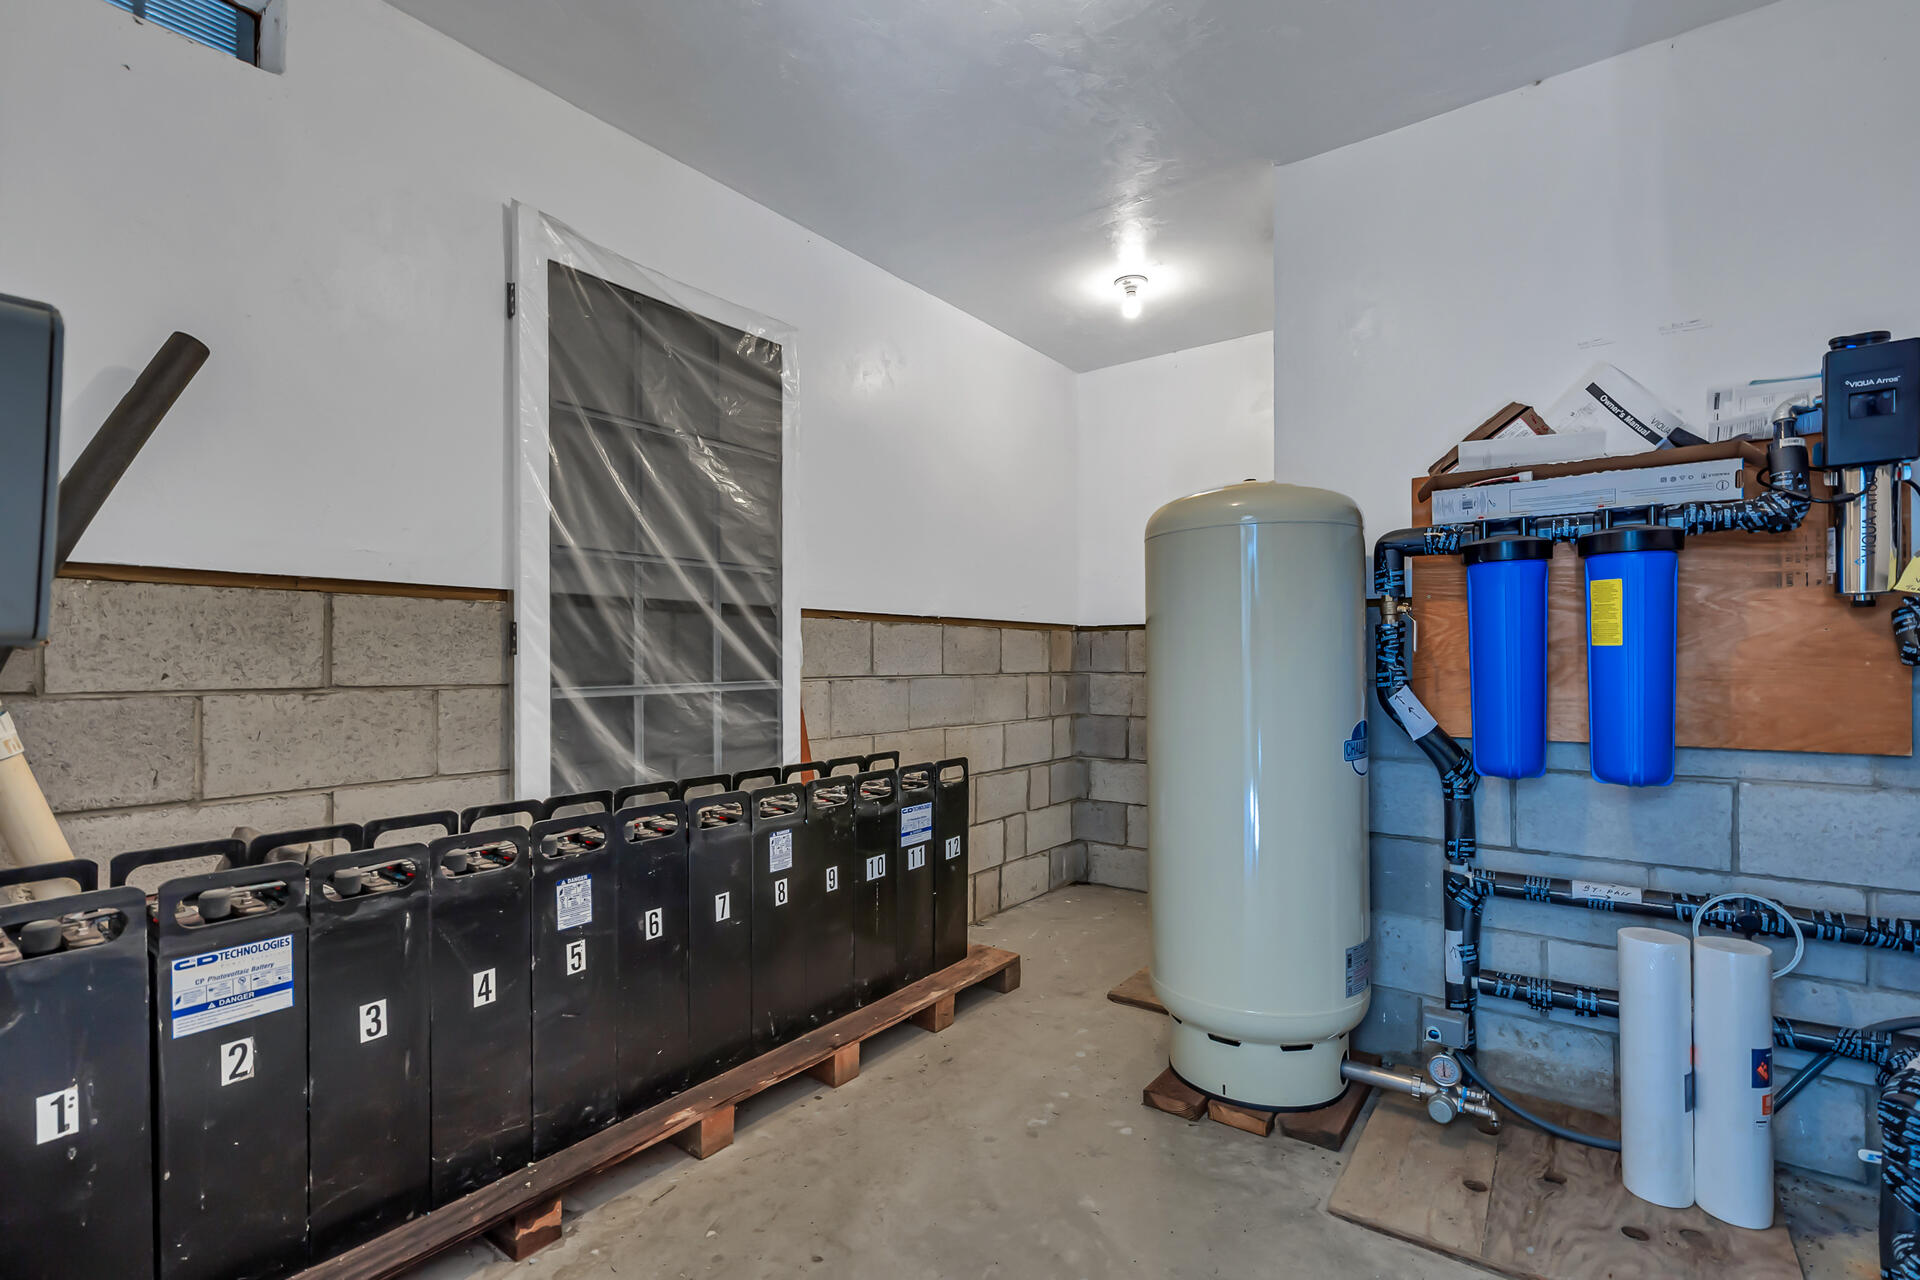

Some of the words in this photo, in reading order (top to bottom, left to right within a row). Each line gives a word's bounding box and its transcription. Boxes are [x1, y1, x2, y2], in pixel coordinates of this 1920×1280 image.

[1849, 378, 1874, 388] VIQUA
[1599, 394, 1625, 418] Owner's
[1624, 414, 1650, 437] Manual
[1650, 416, 1672, 435] VIQUA
[1861, 515, 1877, 558] VIQUA
[910, 847, 924, 868] 11
[947, 838, 960, 858] 12
[828, 869, 836, 889] 9
[869, 856, 884, 879] 10
[777, 881, 786, 903] 8
[718, 895, 727, 919] 7
[649, 911, 659, 937] 6
[219, 937, 290, 961] TECHNOLOGIES
[570, 943, 582, 971] 5
[207, 967, 249, 982] Photovoltaic
[251, 962, 275, 973] Battery
[218, 991, 255, 1006] DANGER
[477, 973, 493, 1002] 4
[365, 1004, 382, 1037] 3
[228, 1042, 248, 1081] 2
